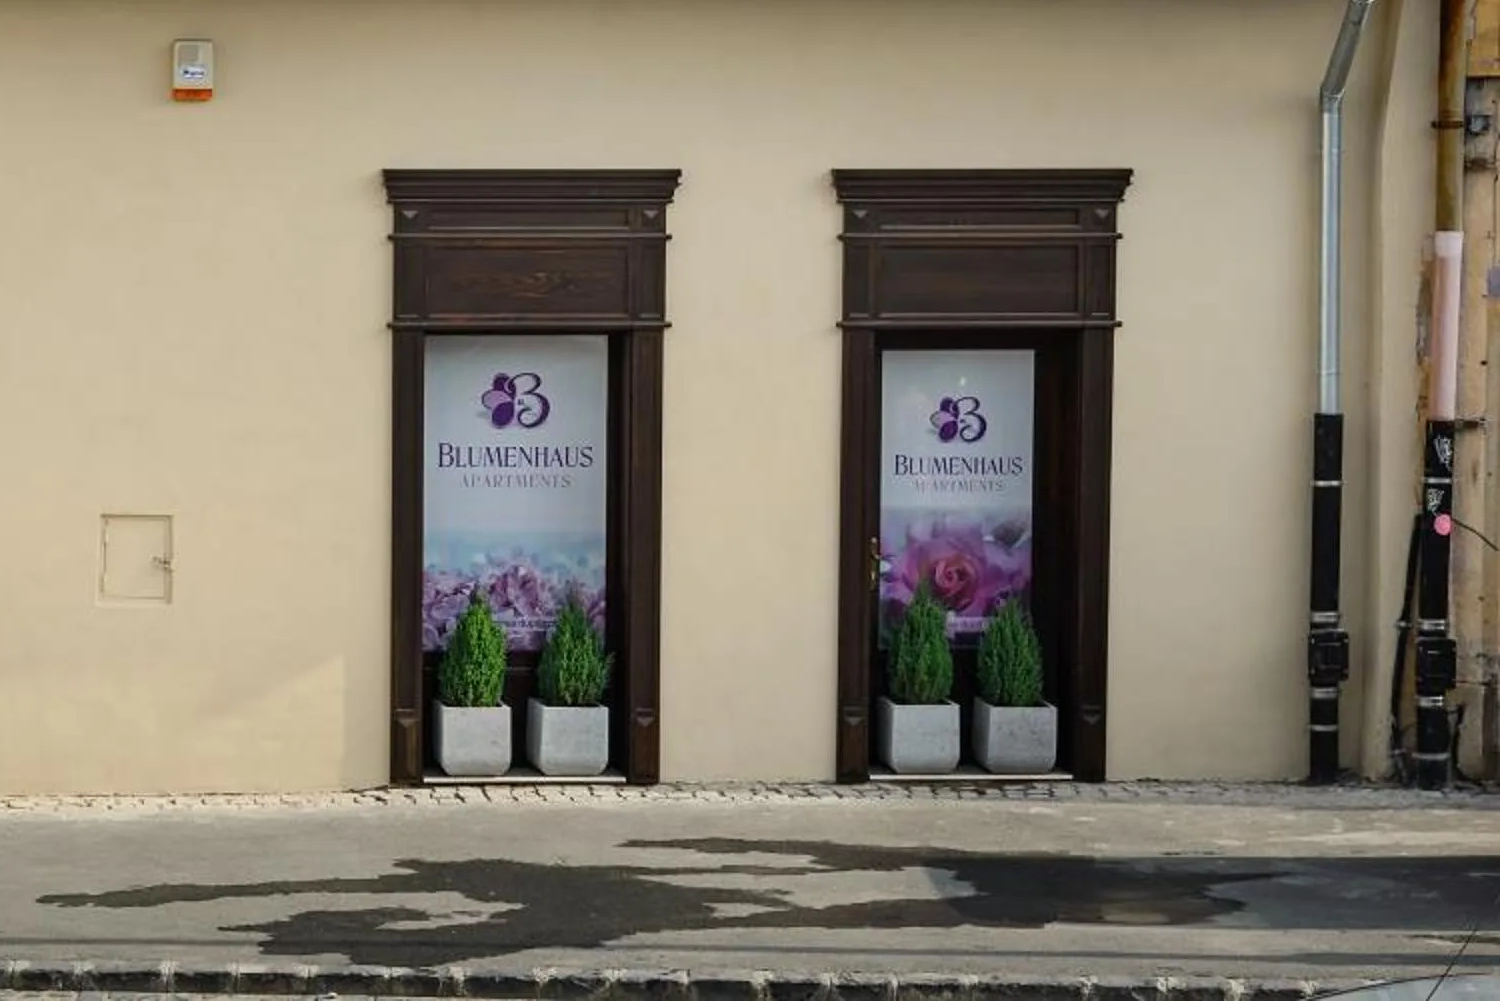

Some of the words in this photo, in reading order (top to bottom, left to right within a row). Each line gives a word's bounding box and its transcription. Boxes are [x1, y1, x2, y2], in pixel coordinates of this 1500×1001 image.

[438, 442, 594, 468] BLUMENHAUS
[895, 454, 1023, 476] BLUMENHAUS
[461, 474, 573, 488] APARTMENTS
